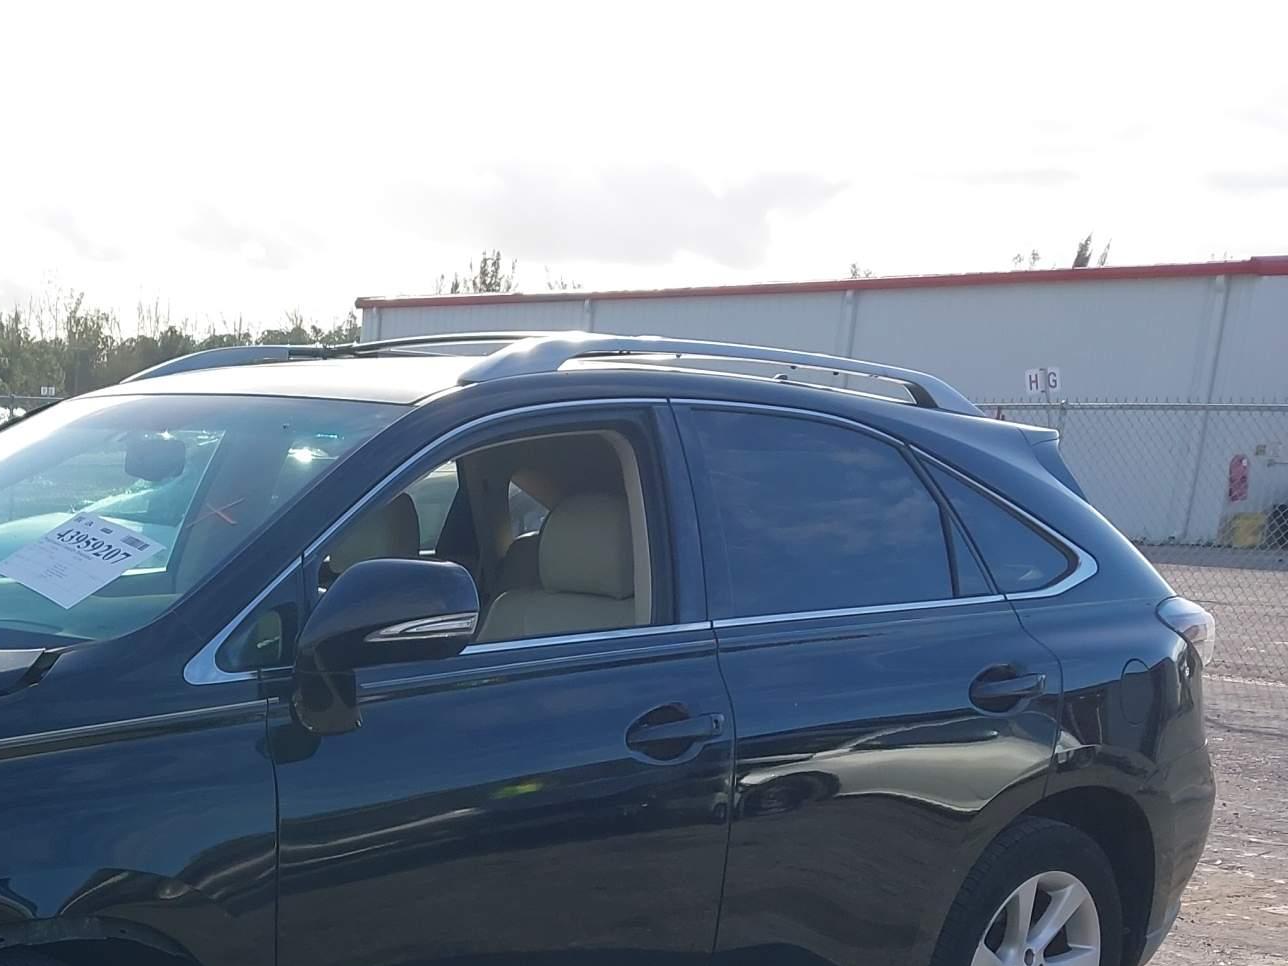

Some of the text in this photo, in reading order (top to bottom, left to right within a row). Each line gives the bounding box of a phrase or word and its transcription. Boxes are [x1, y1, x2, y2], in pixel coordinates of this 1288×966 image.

[1029, 374, 1038, 391] H
[1047, 371, 1057, 389] G
[56, 528, 132, 565] 43959207
